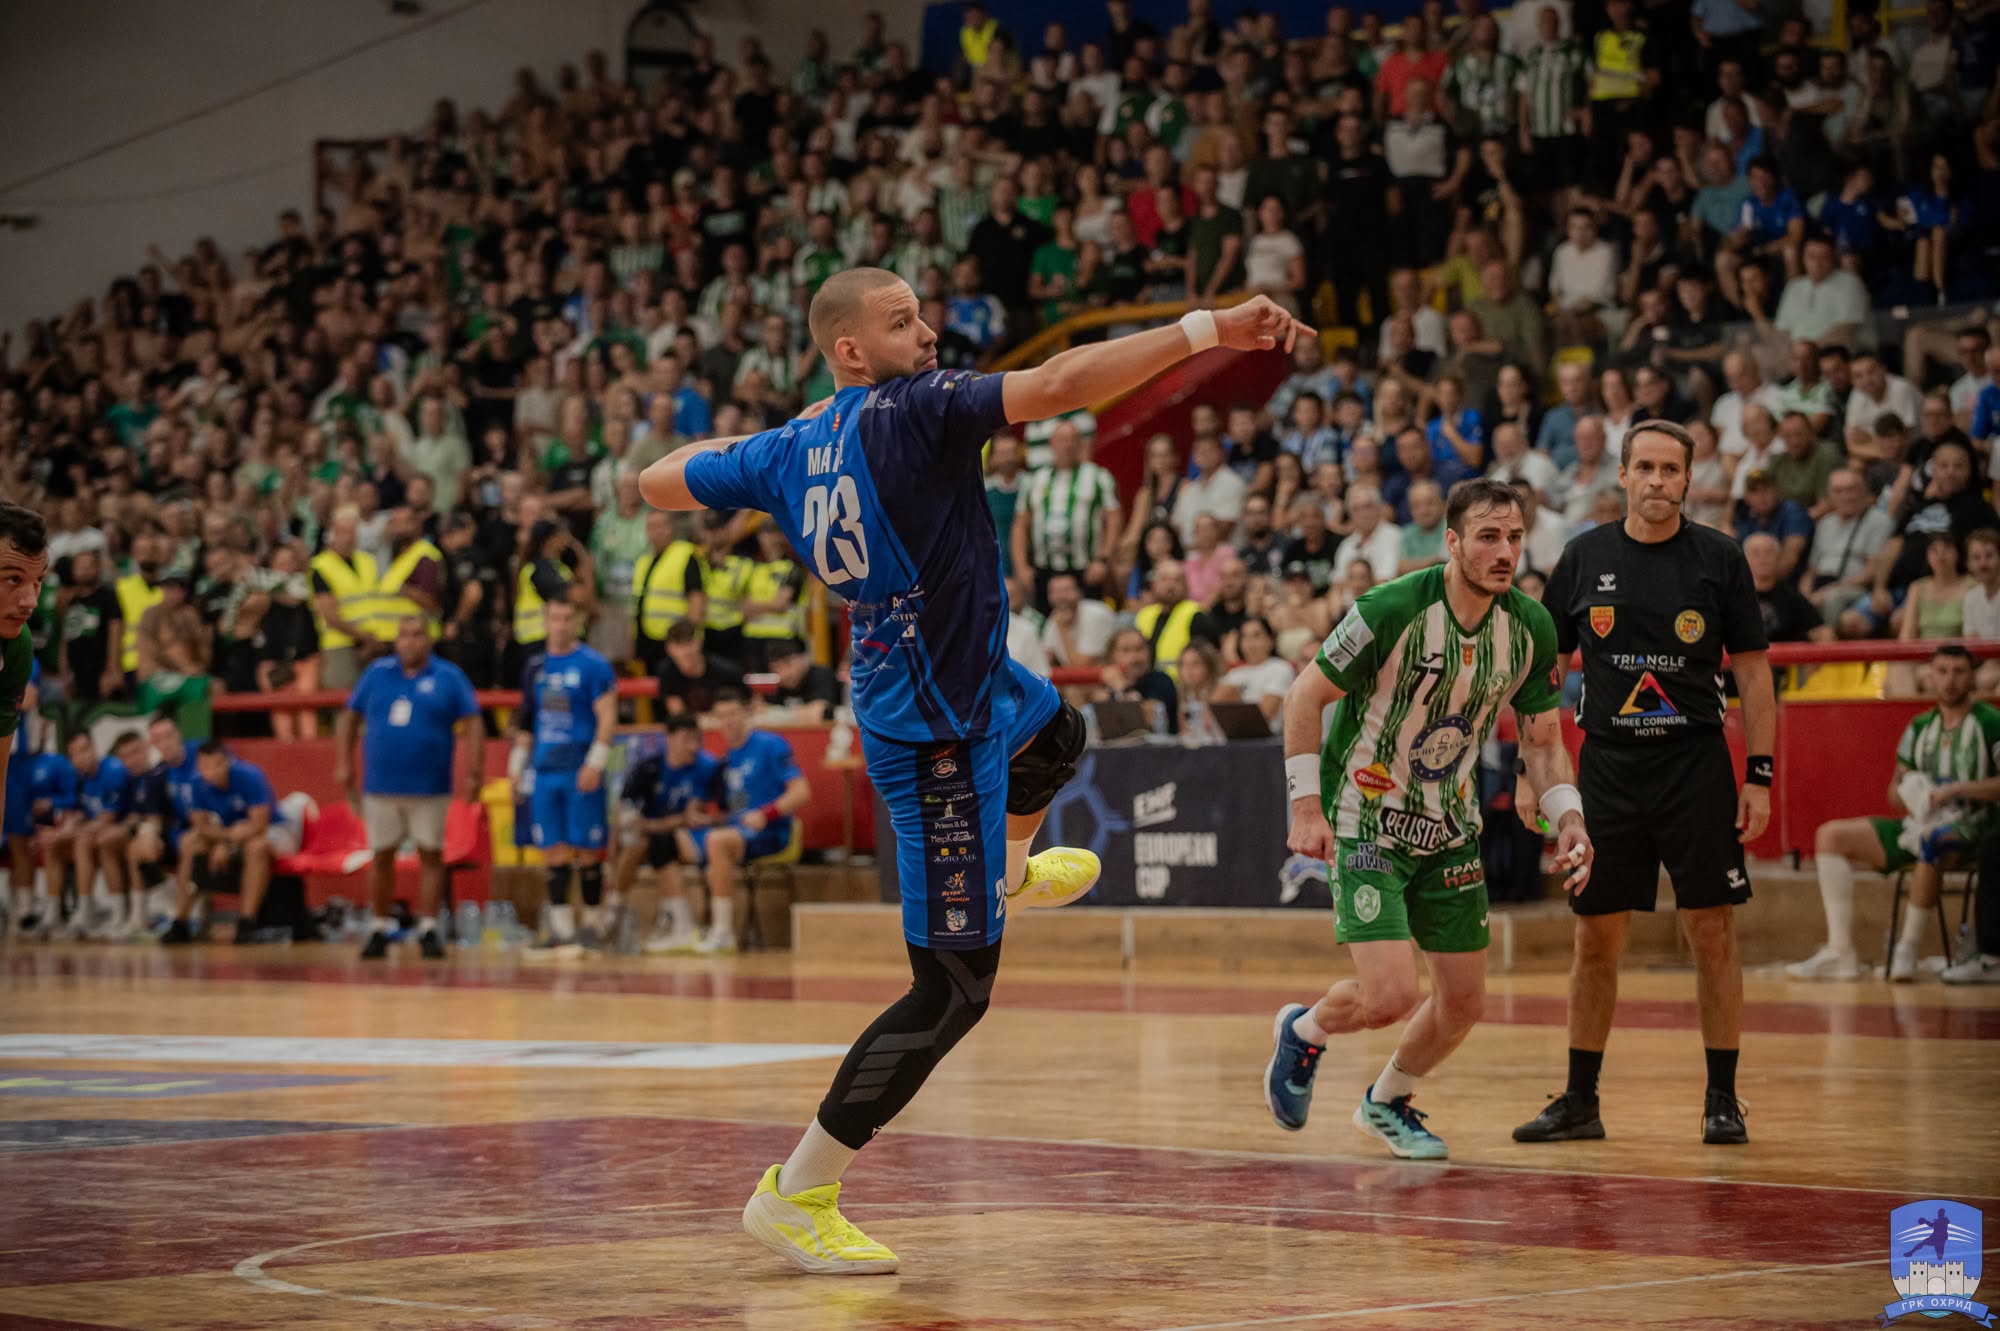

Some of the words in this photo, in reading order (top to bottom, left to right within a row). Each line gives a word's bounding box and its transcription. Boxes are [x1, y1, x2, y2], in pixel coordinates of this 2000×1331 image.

[802, 474, 870, 586] 23
[1611, 653, 1687, 668] TRIANGLE
[1407, 663, 1446, 706] 77
[1611, 716, 1641, 727] THREE
[1642, 715, 1688, 727] CORNERS
[1634, 727, 1668, 737] HOTEL
